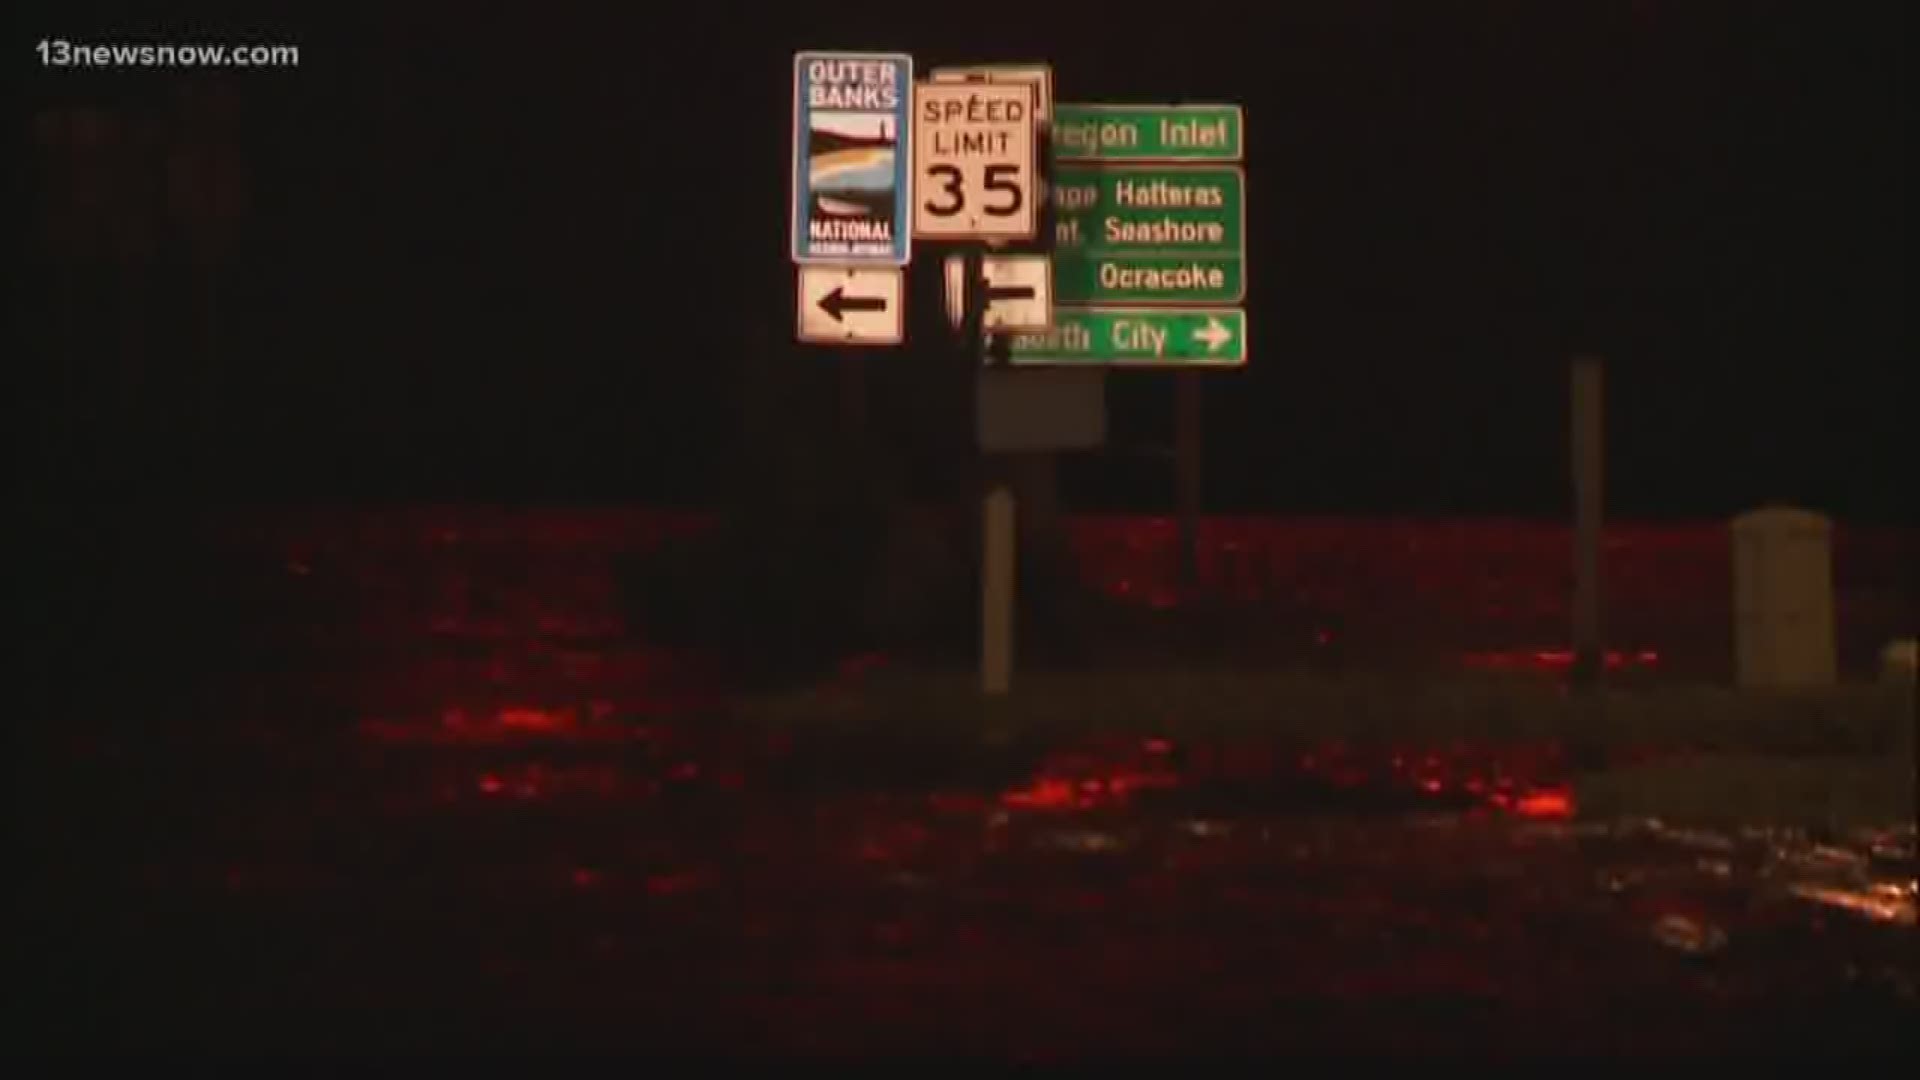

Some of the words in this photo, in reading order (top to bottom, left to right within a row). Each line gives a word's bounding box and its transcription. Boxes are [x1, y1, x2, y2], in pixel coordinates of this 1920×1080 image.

[809, 60, 896, 82] OUTER
[809, 85, 897, 108] BANKS
[923, 101, 1023, 122] SPEED
[935, 131, 1009, 155] LIMIT
[1160, 118, 1228, 146] Inlet
[924, 164, 1023, 217] 35
[1116, 180, 1223, 206] Hatteras
[810, 219, 891, 241] NATIONAL
[1105, 215, 1224, 242] Seashore
[1100, 262, 1224, 290] Ocracoke
[1112, 320, 1168, 357] City
